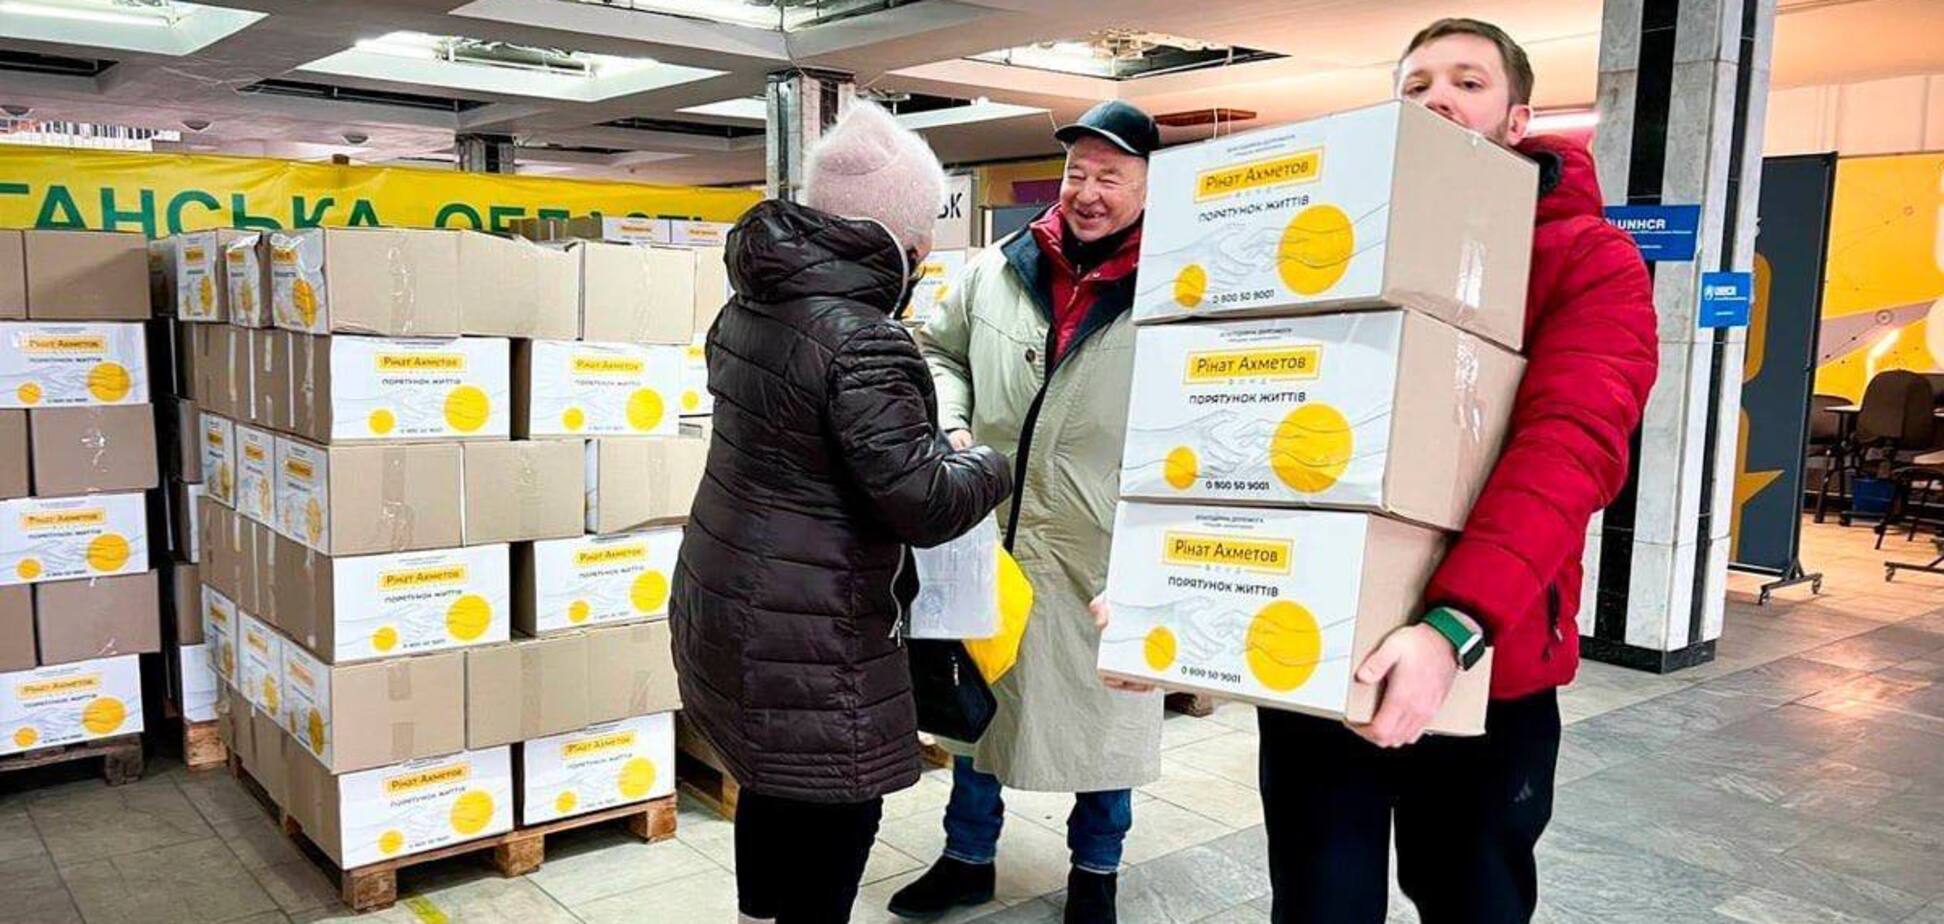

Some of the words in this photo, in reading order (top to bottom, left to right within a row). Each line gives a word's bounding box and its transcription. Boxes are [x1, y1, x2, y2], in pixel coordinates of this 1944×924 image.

[1205, 174, 1241, 191] Рінат
[1245, 161, 1309, 181] Ахметов
[0, 183, 381, 240] АНСЬКА
[1199, 204, 1262, 222] ПОРЯТУНОК
[1266, 194, 1309, 210] ЖИТТІВ
[1617, 218, 1667, 230] UNHCR
[1197, 358, 1235, 373] Рінат
[1238, 356, 1307, 370] Ахметов
[1189, 393, 1258, 405] ПОРЯТУНОК
[1260, 391, 1307, 403] ЖИТТІВ
[1175, 539, 1212, 557] Рінат
[1213, 543, 1279, 563] Ахметов
[1168, 575, 1233, 592] ПОРЯТУНОК
[1235, 583, 1280, 598] ЖИТТІВ
